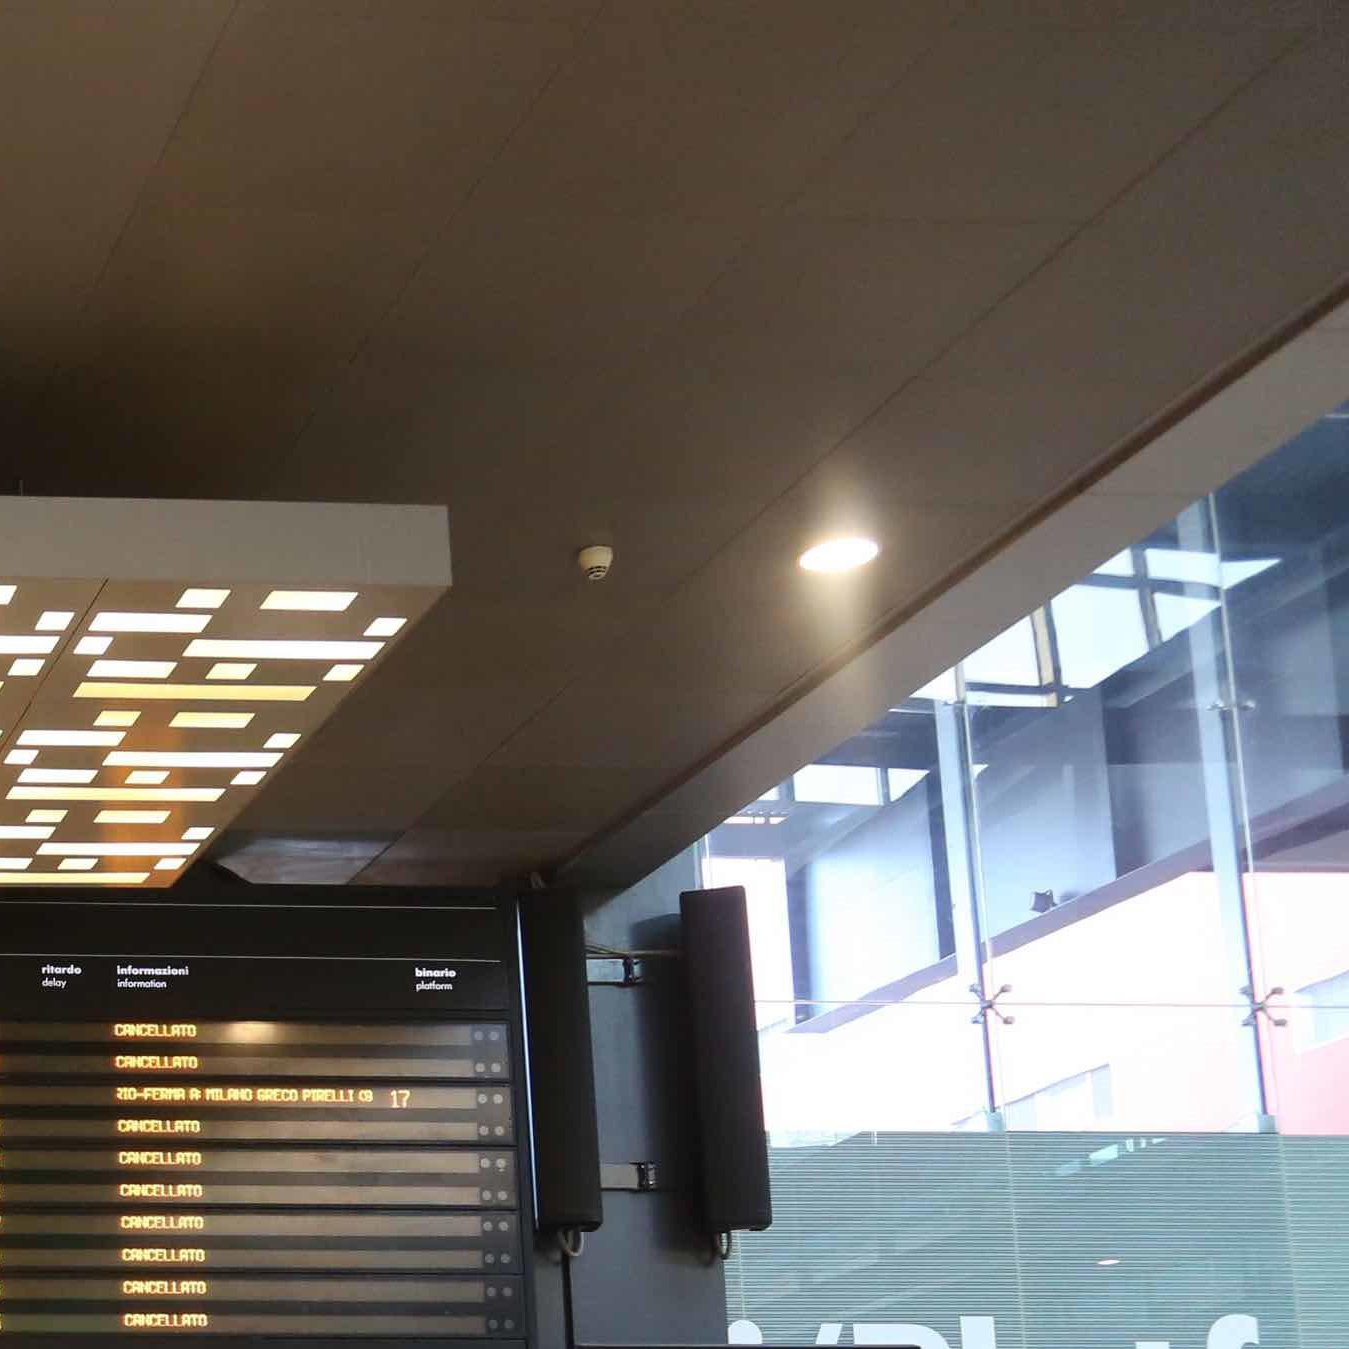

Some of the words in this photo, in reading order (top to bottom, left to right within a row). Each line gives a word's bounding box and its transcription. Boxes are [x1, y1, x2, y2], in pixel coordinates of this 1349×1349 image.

[42, 965, 81, 975] ritardo
[117, 966, 189, 976] informazioni
[415, 968, 456, 978] binario
[42, 978, 66, 989] delay
[117, 979, 167, 989] information
[416, 981, 452, 992] platform
[390, 1090, 410, 1108] 17
